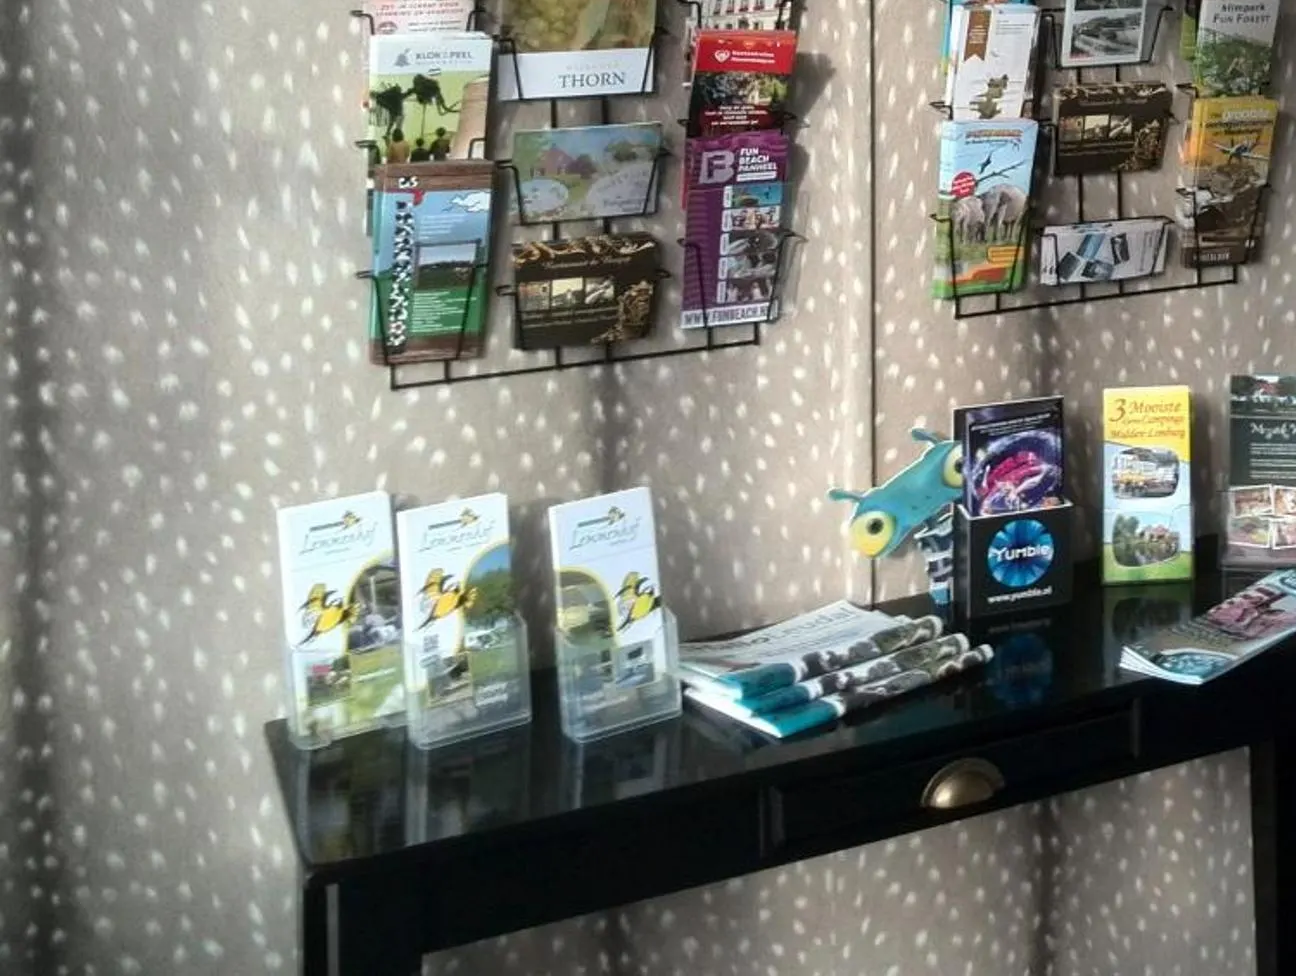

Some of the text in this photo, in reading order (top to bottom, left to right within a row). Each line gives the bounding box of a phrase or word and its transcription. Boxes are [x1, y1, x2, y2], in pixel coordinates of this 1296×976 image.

[558, 71, 626, 89] THORN
[739, 147, 759, 156] FUN
[739, 155, 769, 164] BEACH
[1109, 398, 1127, 423] 3
[1129, 401, 1182, 415] Mooiste
